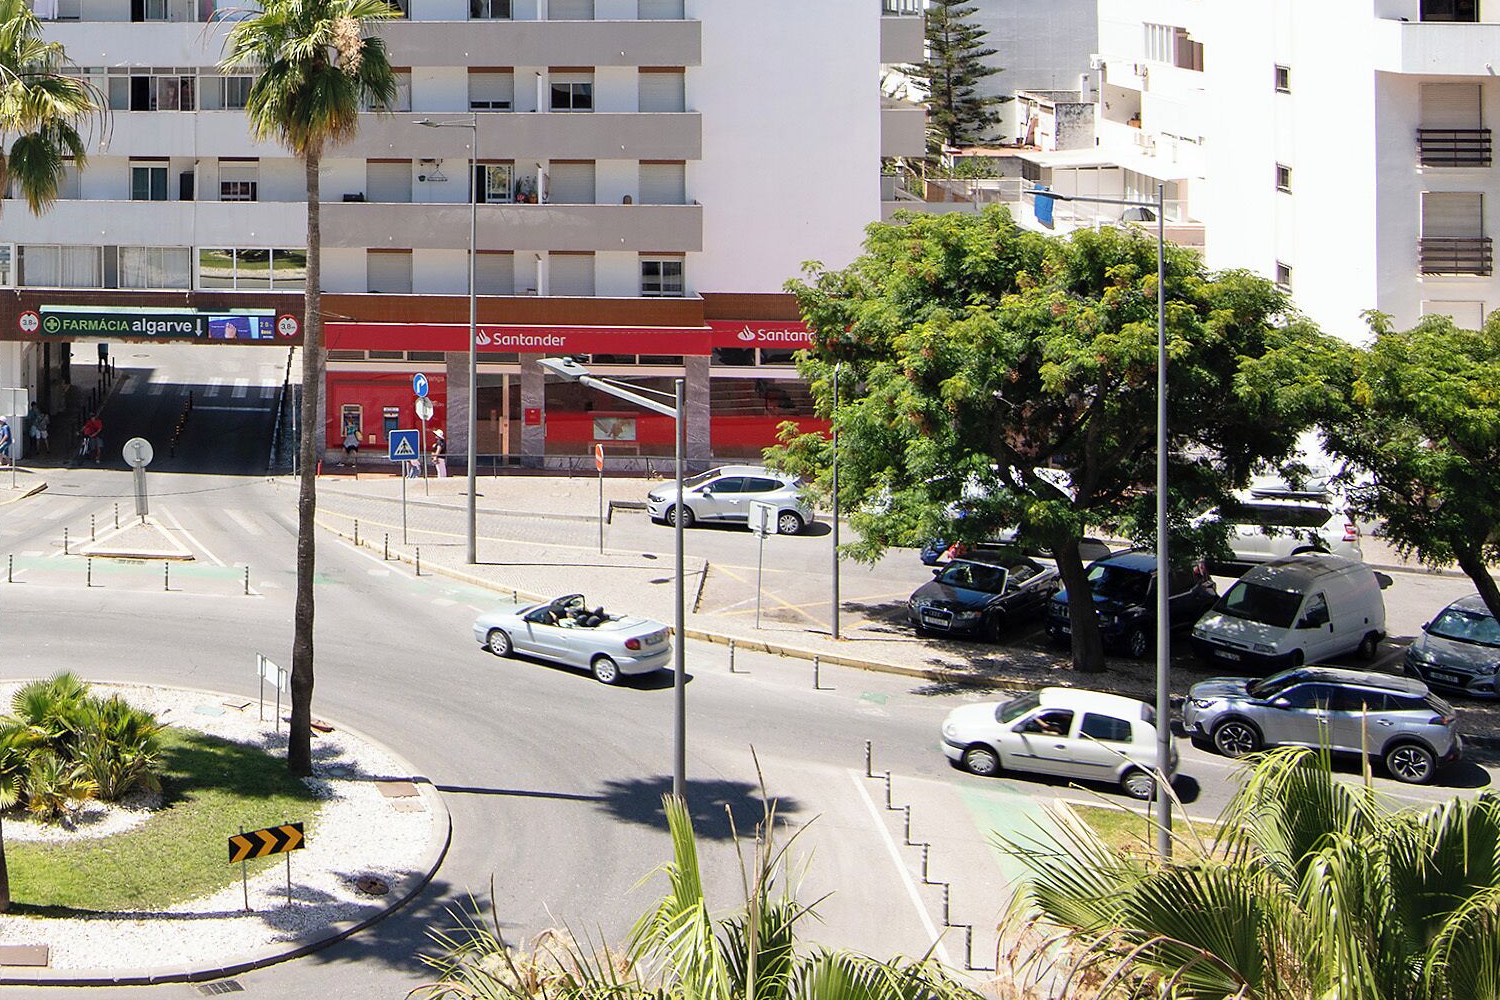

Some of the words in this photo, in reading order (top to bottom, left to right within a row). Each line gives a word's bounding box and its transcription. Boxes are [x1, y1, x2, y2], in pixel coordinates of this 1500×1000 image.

[63, 319, 129, 331] FARMÁCIA
[132, 318, 192, 335] algarve
[493, 333, 566, 347] Santander
[757, 329, 815, 342] Santan
